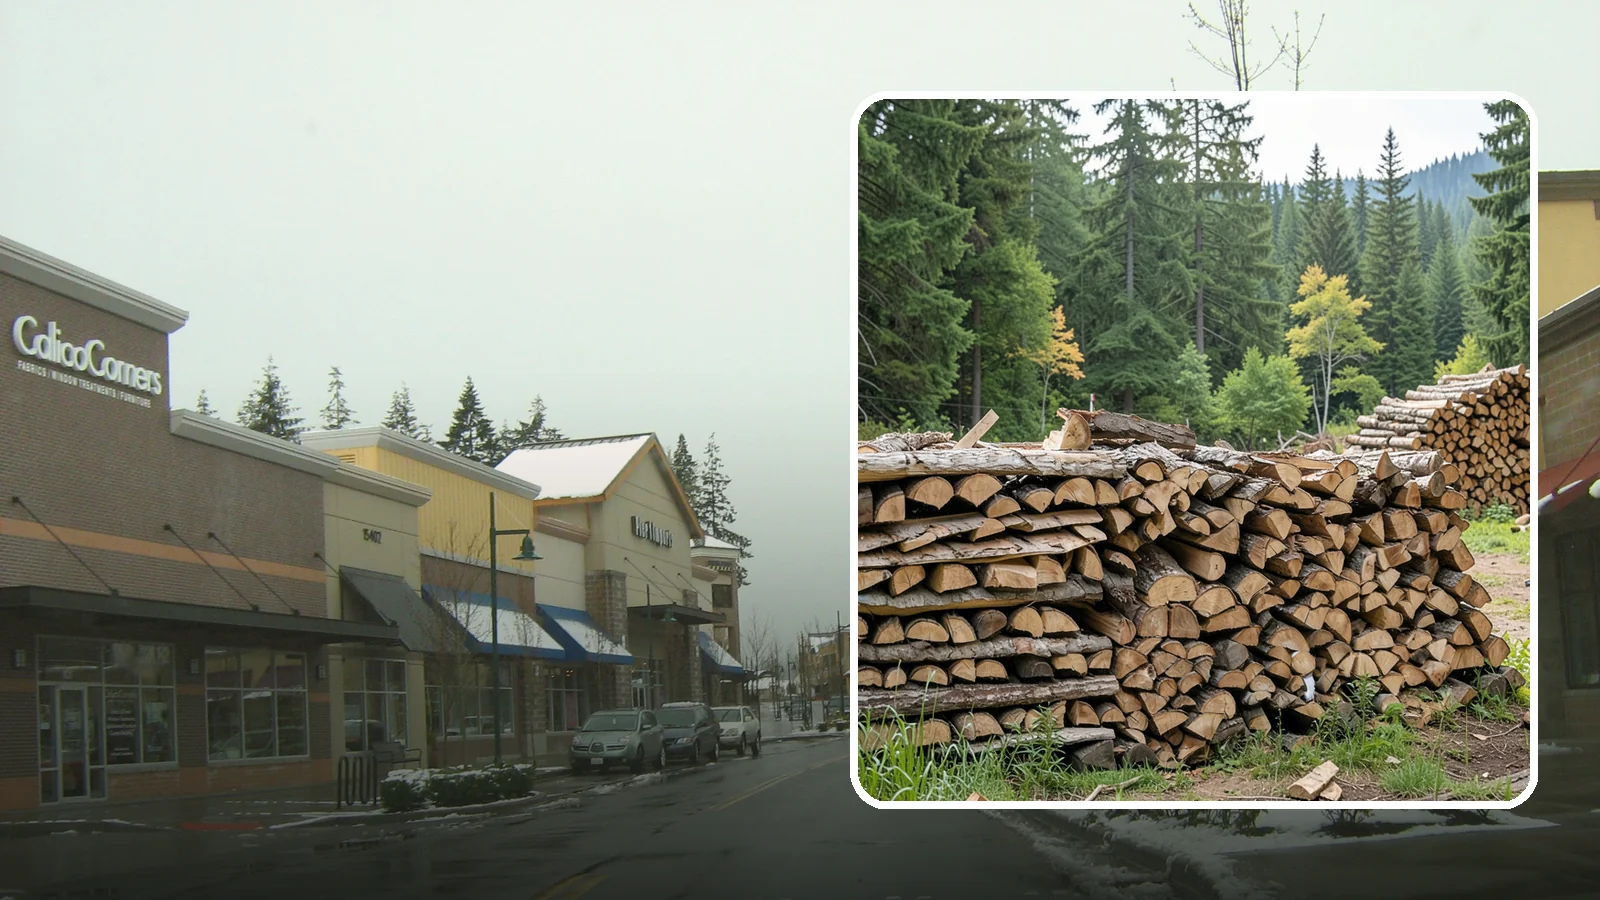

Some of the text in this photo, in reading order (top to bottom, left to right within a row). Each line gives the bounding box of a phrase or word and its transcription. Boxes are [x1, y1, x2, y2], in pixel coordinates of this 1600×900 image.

[16, 359, 151, 409] FABRICS WINDOW TREATMENTS FURNITURE
